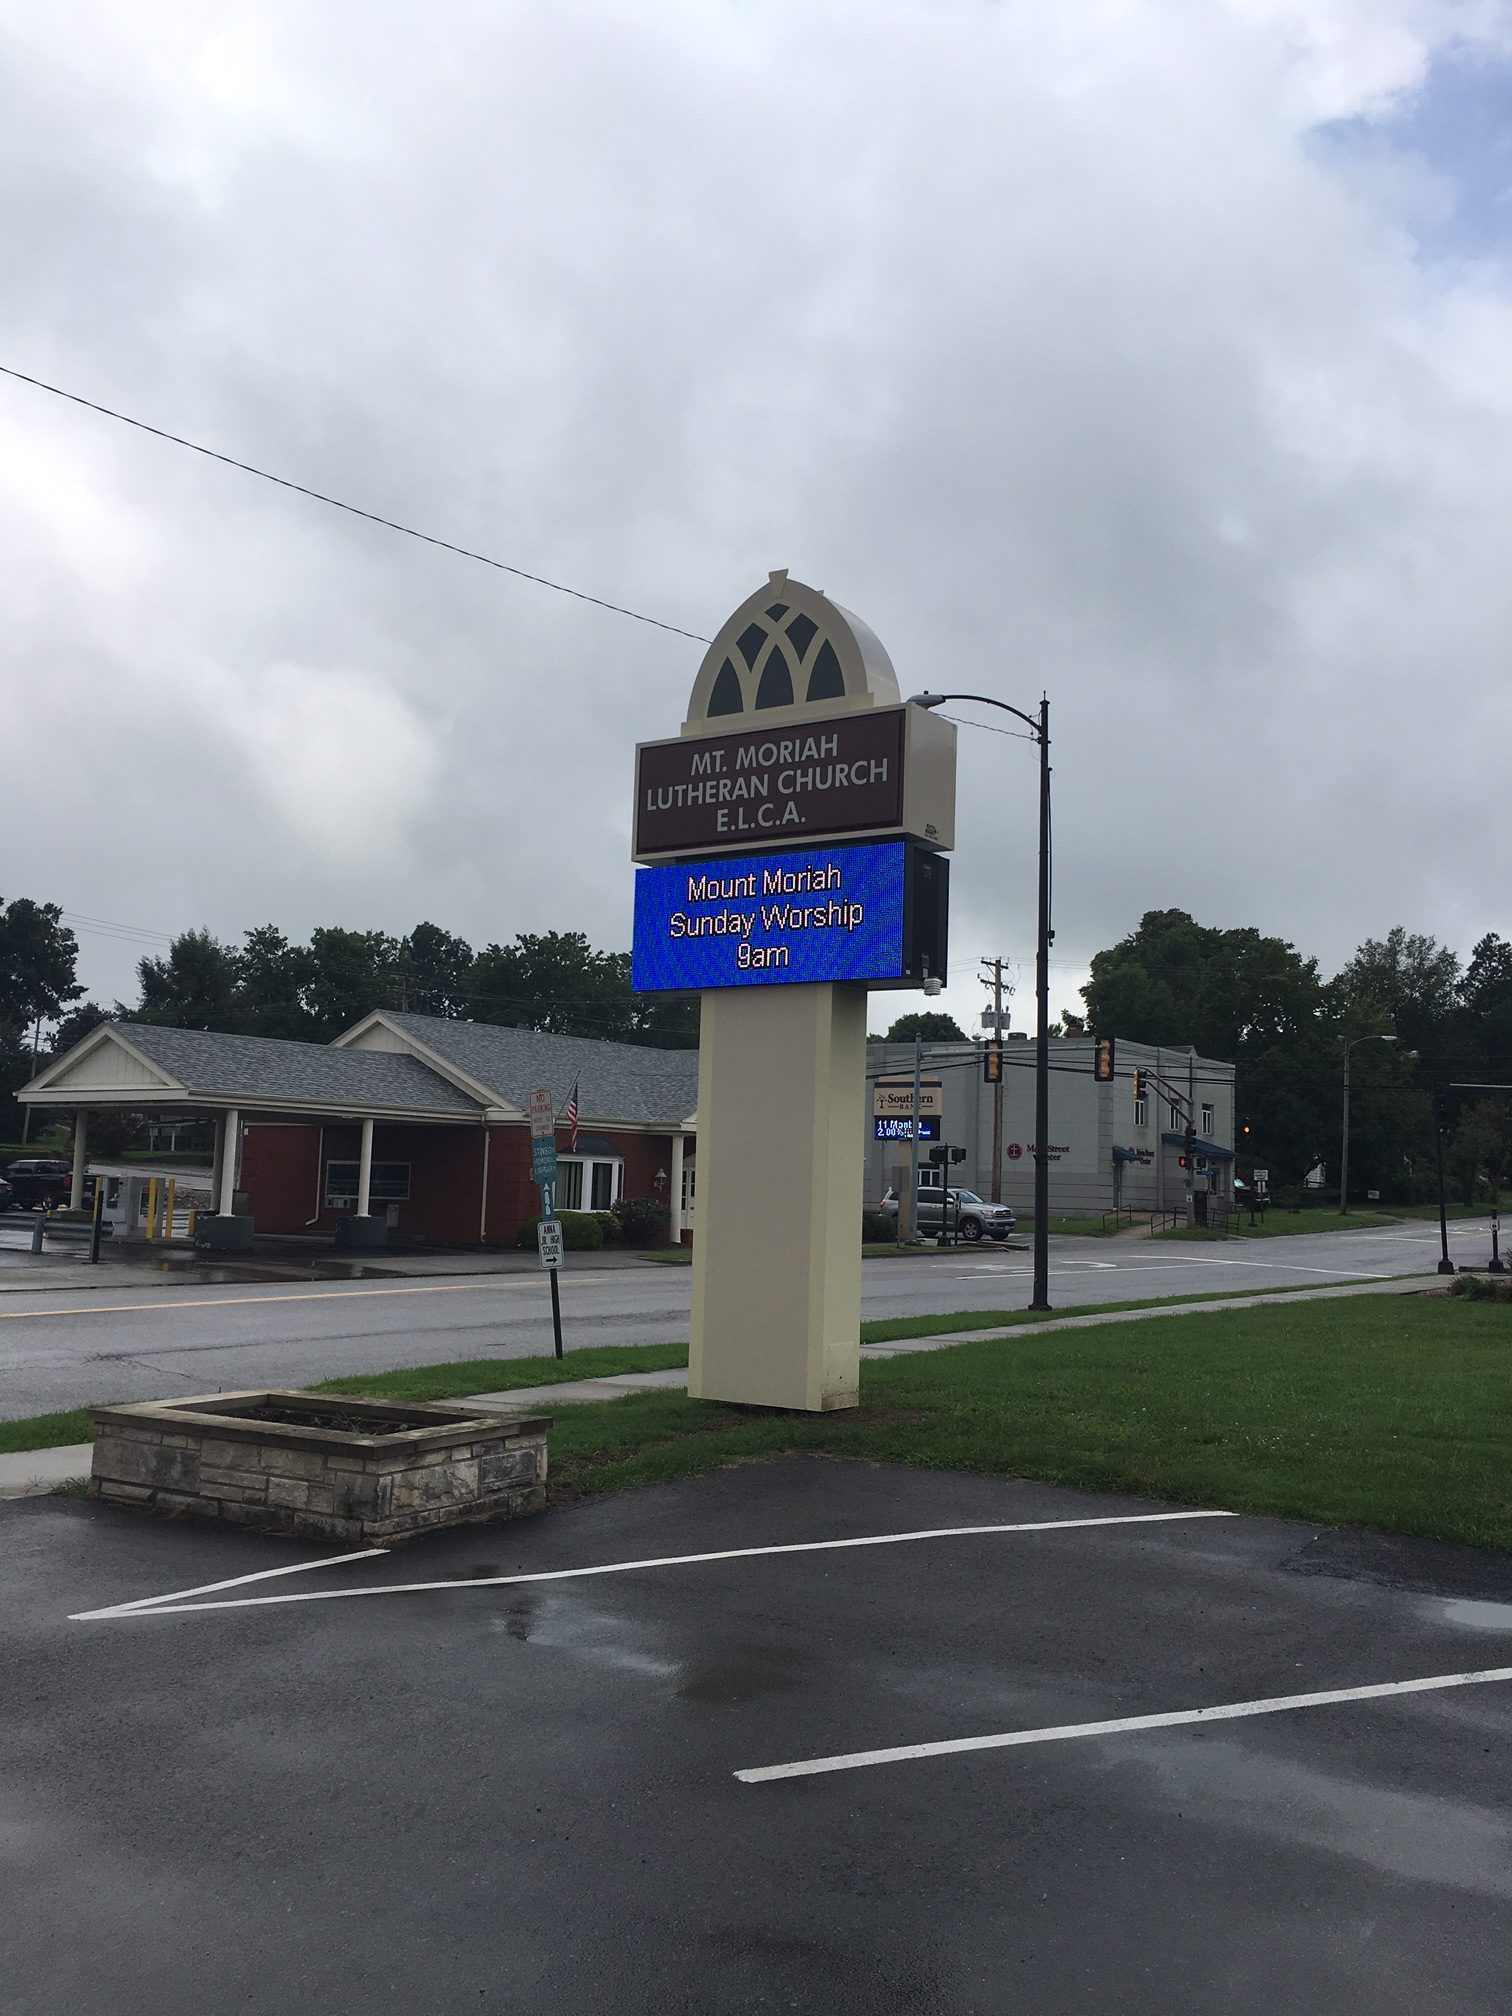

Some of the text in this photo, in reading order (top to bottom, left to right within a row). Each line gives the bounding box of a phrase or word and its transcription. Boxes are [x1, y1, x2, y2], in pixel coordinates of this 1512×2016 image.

[690, 733, 839, 777] MT. MORIAH
[646, 758, 889, 811] LUTHERAN CHURCH
[716, 800, 807, 833] E.L.C.A.
[687, 864, 842, 902] Mount Moriah
[669, 898, 864, 939] Sunday Worship
[737, 943, 790, 970] 9am
[536, 1094, 546, 1104] NO
[543, 1224, 557, 1235] ANNA
[542, 1245, 560, 1256] SCHOOL
